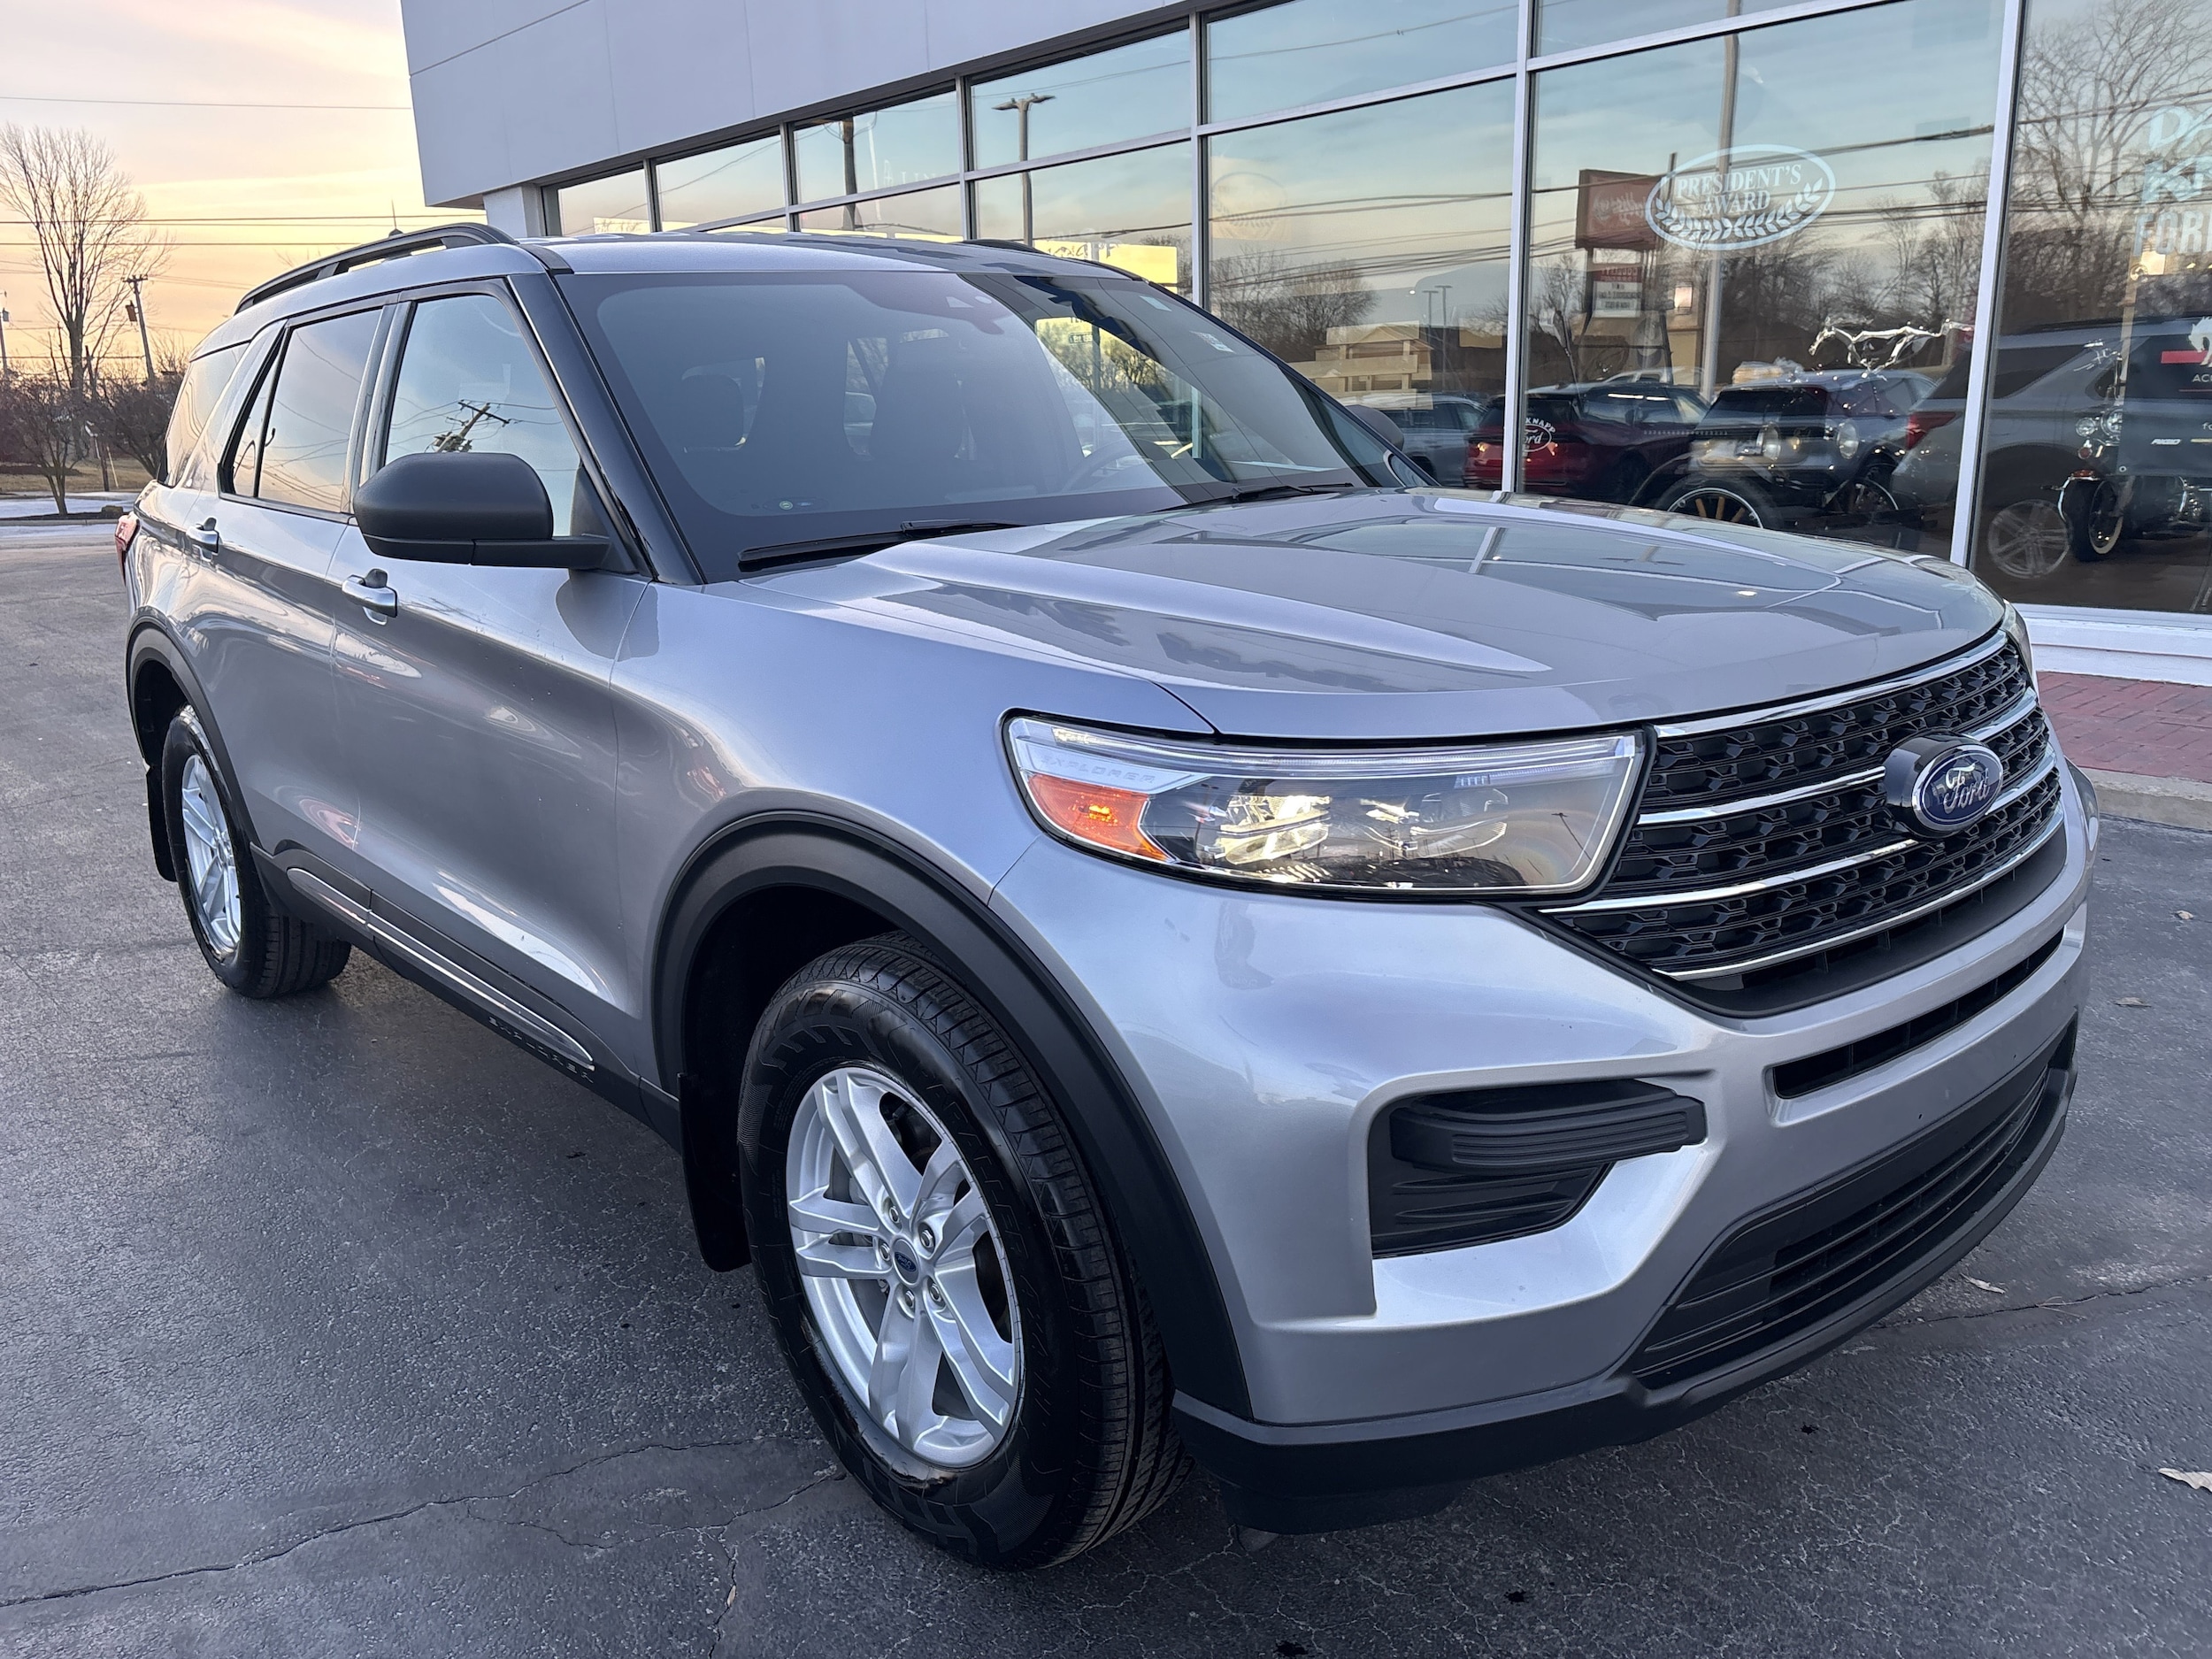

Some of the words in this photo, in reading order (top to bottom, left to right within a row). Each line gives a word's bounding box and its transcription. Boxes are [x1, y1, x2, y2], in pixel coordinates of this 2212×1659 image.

[1675, 164, 1802, 200] PRESIDENT'S
[1702, 188, 1771, 217] AWARD
[2133, 209, 2212, 257] FOR
[1942, 762, 1991, 814] Ford
